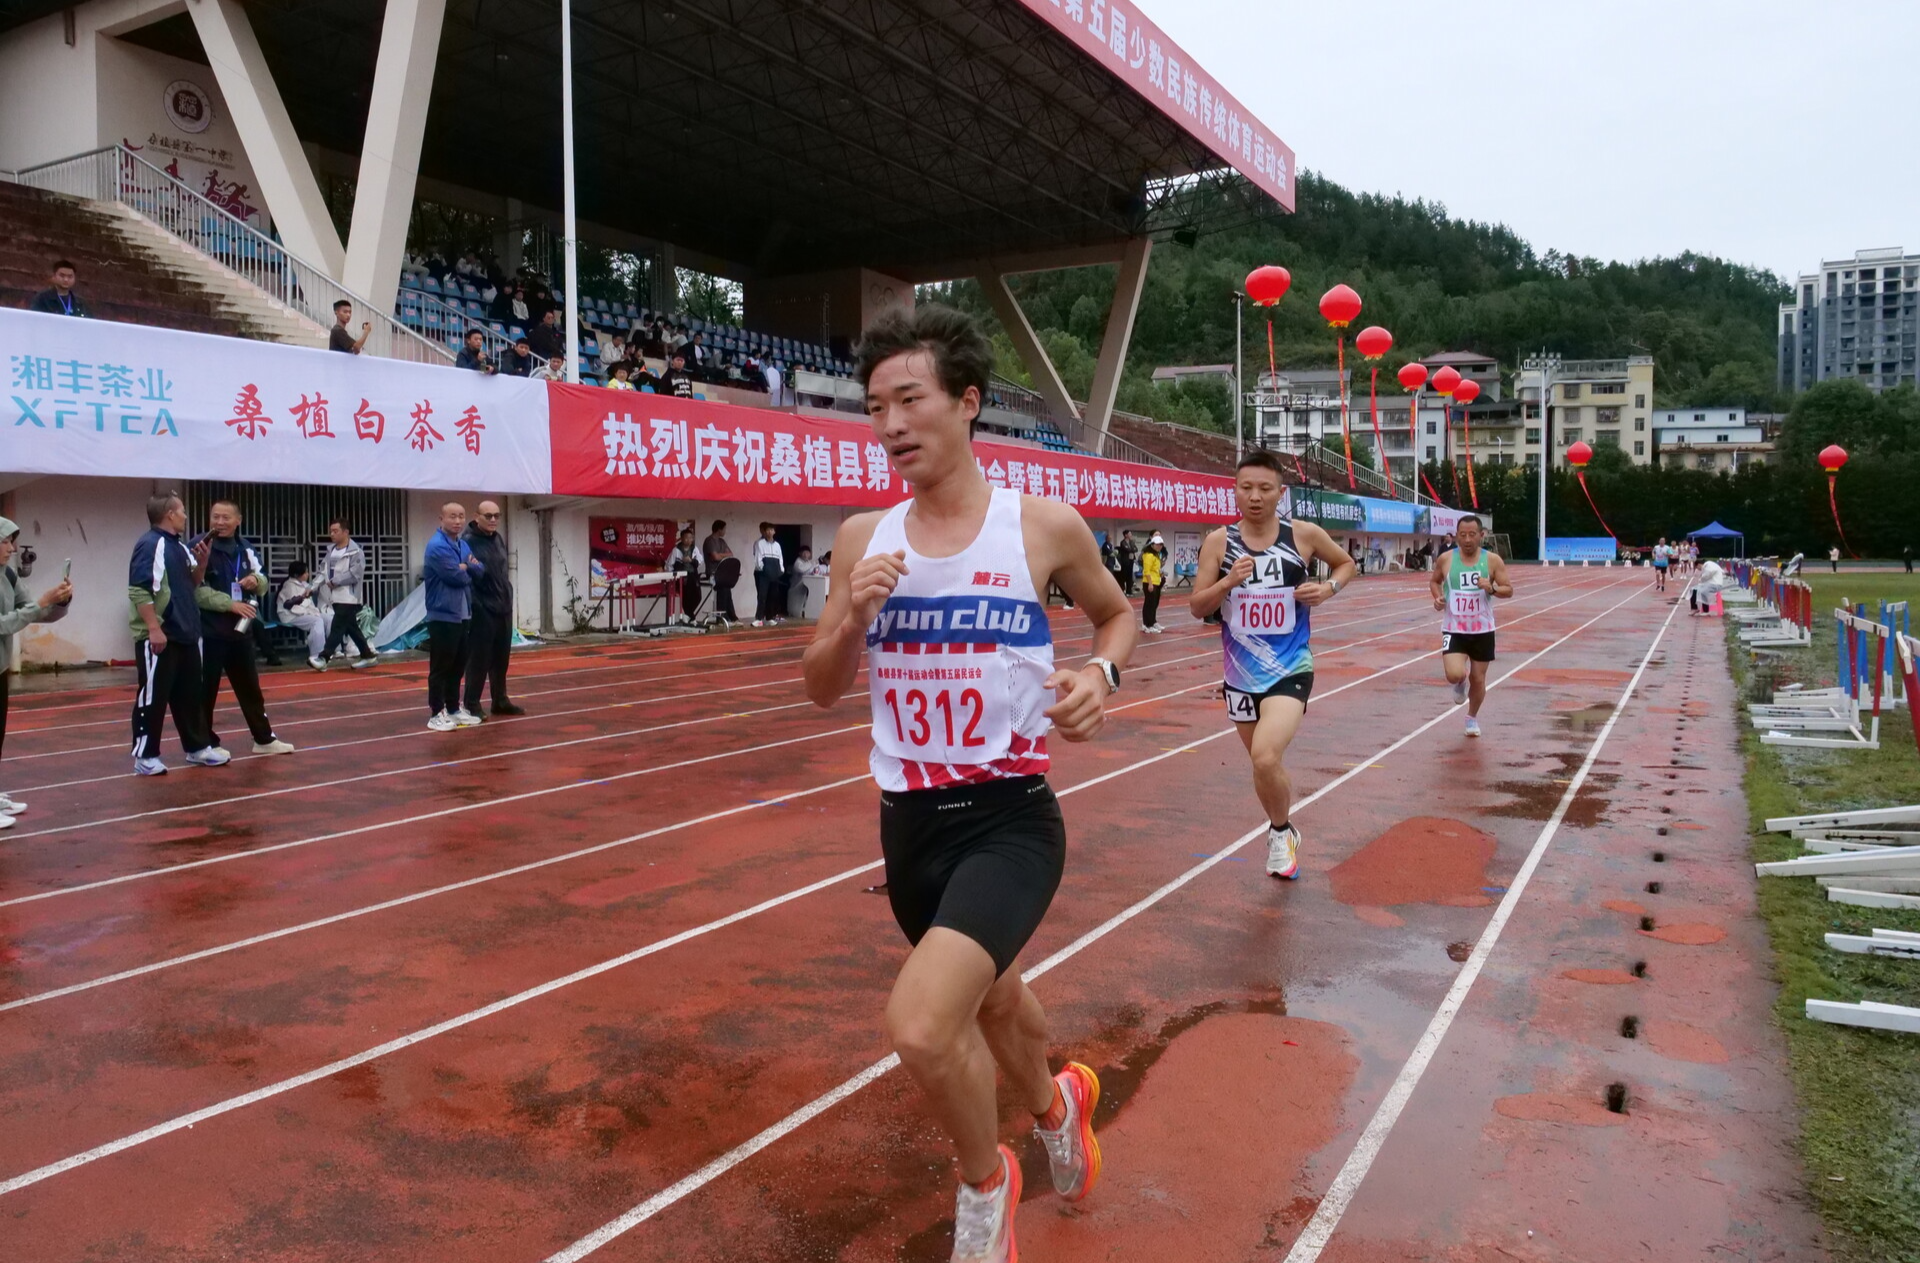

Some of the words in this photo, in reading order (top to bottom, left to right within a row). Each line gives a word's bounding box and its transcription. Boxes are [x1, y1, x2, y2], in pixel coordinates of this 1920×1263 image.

[1049, 0, 1287, 192] 第五届少数民族传统体育运动会
[10, 354, 174, 402] 湘丰茶业
[10, 395, 179, 437] XFTEA
[224, 383, 486, 456] 桑植白茶香
[1249, 557, 1282, 585] 14
[1461, 572, 1480, 587] 16
[950, 600, 1031, 634] club
[1239, 602, 1285, 629] 1600
[1456, 597, 1480, 612] 1741
[884, 687, 986, 748] 1312
[1227, 693, 1254, 717] 14
